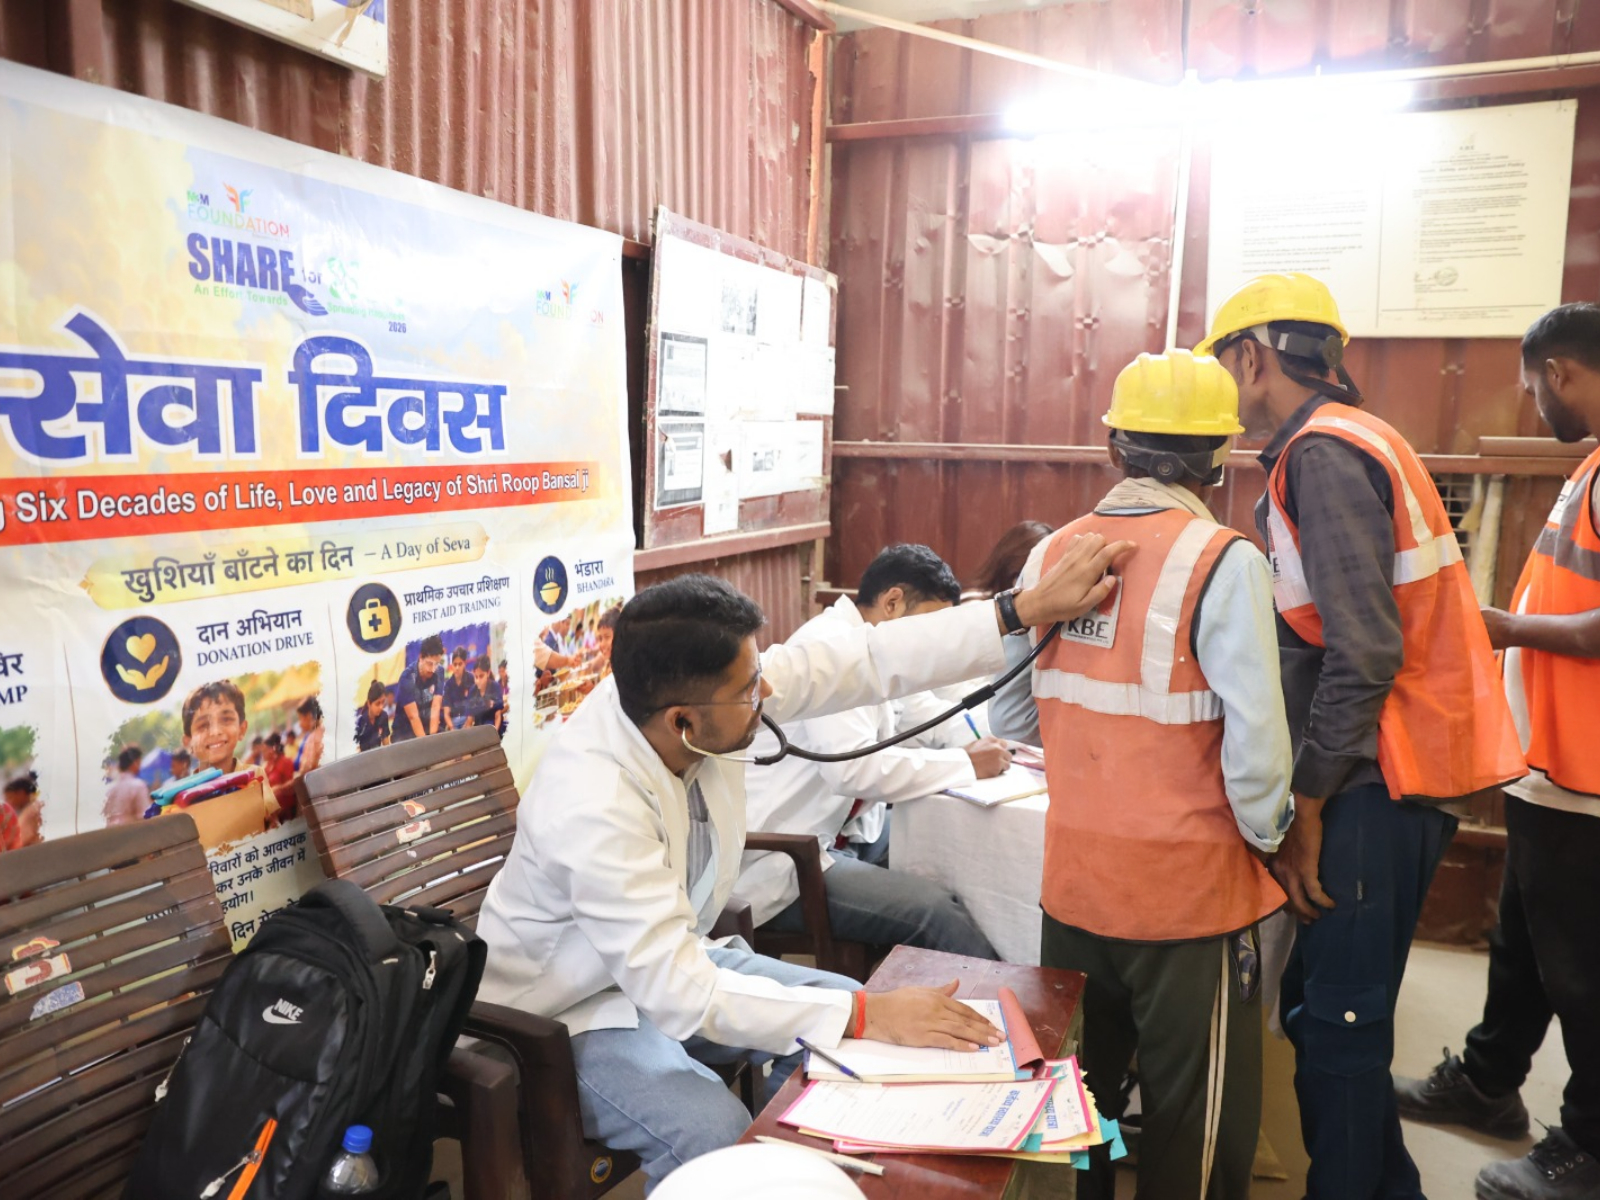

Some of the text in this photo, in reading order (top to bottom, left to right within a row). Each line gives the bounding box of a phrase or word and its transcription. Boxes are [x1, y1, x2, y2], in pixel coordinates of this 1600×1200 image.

[188, 204, 290, 238] FOUNDATION
[187, 232, 295, 293] SHARE
[194, 284, 288, 306] An Effort Towards
[388, 321, 407, 334] 2026
[536, 301, 604, 324] FOUNDON
[289, 335, 507, 453] दिवस
[16, 491, 68, 523] Six
[77, 487, 197, 521] Decades
[204, 484, 229, 512] of
[234, 483, 284, 512] Life,
[288, 481, 338, 507] Love
[343, 479, 378, 504] and
[382, 475, 442, 503] Legacy
[446, 475, 463, 497] of
[466, 473, 499, 495] Shri
[502, 472, 540, 495] Roop
[542, 470, 580, 491] Bansal
[581, 469, 590, 493] ji
[381, 546, 393, 560] A
[396, 543, 423, 563] Day
[426, 540, 441, 555] of
[443, 538, 471, 553] Seva
[121, 541, 355, 603] खुशियाँ बाँटने का दिन
[574, 559, 604, 578] भंडारा
[404, 575, 510, 608] प्राथमिक उपचार प्रशिक्षण
[577, 576, 615, 594] BHANDARA
[413, 597, 501, 624] FIRST AID TRAINING
[196, 609, 303, 645] दान अभियान
[1067, 617, 1109, 639] KBE
[197, 632, 314, 667] DONATION DRIVE
[208, 831, 307, 875] रिवारों को आवश्यक
[216, 878, 233, 894] कर
[237, 865, 263, 886] उनके
[266, 855, 294, 874] जीवन
[231, 920, 255, 942] दिन
[274, 998, 304, 1021] NIKE
